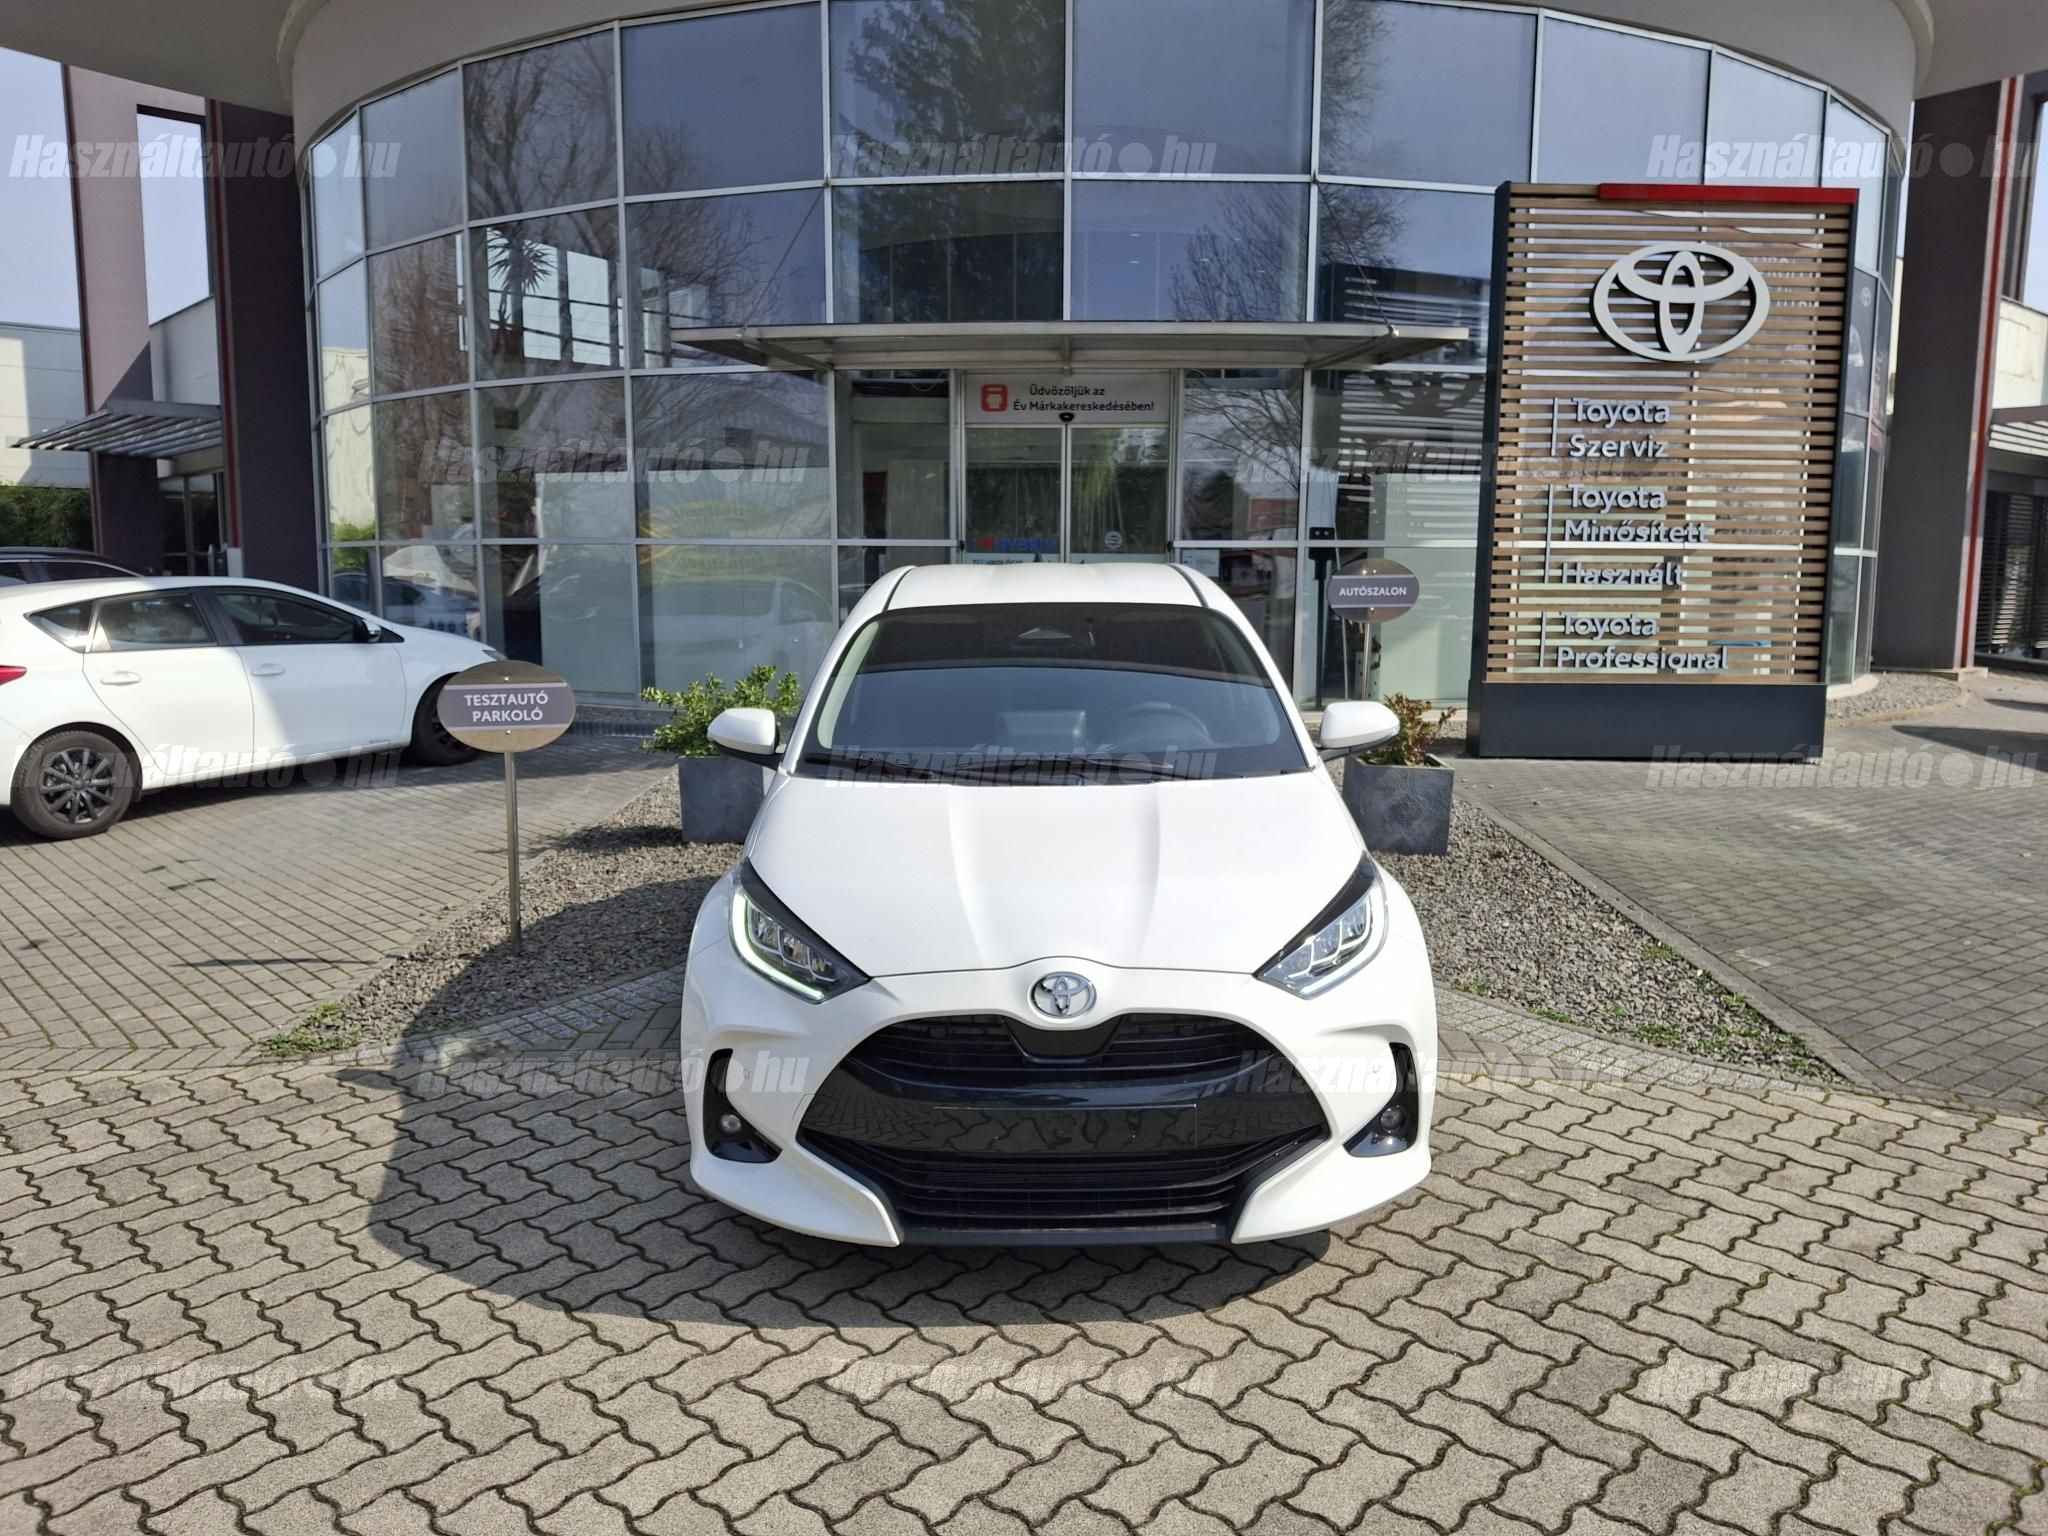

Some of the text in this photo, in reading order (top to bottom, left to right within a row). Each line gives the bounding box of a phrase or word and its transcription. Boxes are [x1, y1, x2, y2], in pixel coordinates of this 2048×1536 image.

[1029, 384, 1106, 398] Üdvözöljük az
[1013, 399, 1154, 411] Év Márkakereskedésében!
[1571, 397, 1671, 429] Toyota
[1569, 433, 1669, 458] Szerviz
[1567, 483, 1667, 514] Toyota
[1564, 518, 1709, 543] Minősített
[1562, 563, 1686, 586] Használt
[1338, 586, 1407, 598] AUTÓSZALON
[1559, 611, 1658, 640] Toyota
[1557, 645, 1729, 670] Professional
[463, 690, 549, 706] TESZTAUTÓ
[472, 706, 544, 723] PARKOLÓ
